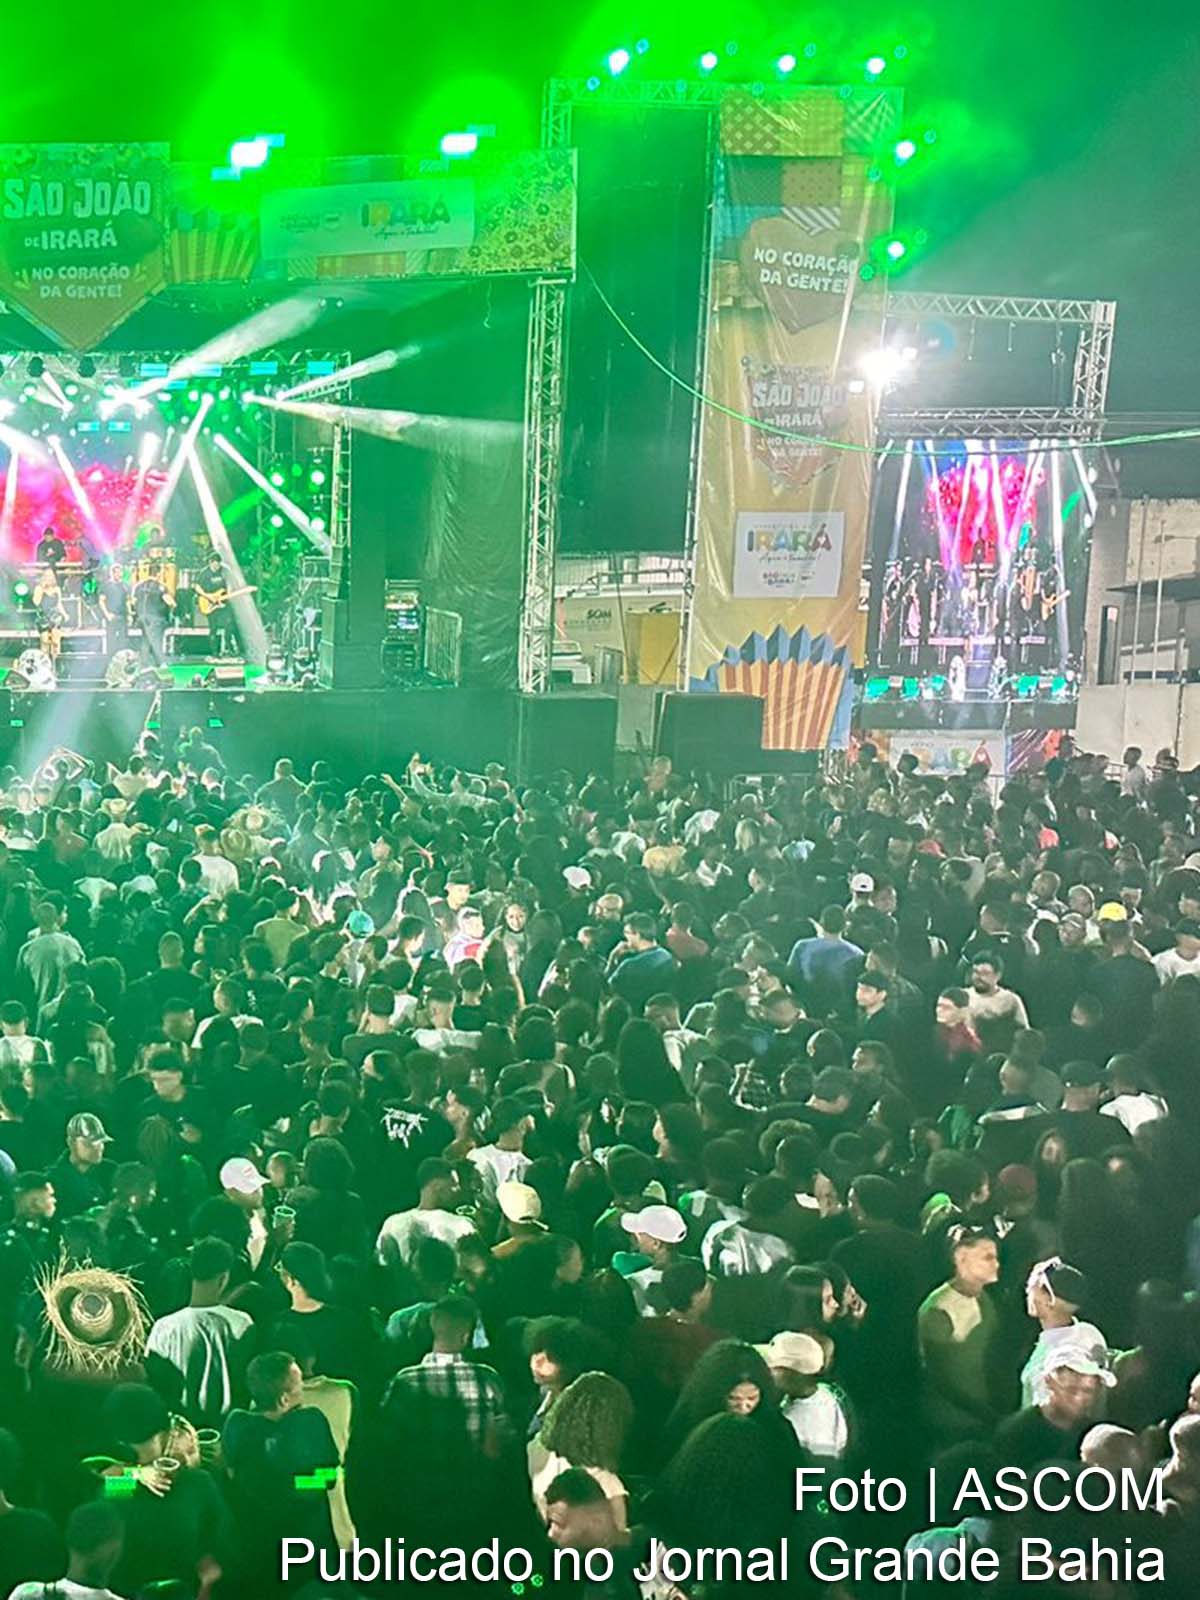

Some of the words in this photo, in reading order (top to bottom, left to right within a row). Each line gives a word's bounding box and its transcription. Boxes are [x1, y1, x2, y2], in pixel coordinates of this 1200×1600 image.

[3, 174, 64, 219] SÃO
[73, 174, 151, 219] JOÃO
[41, 220, 118, 250] IRARÁ
[31, 266, 53, 281] NO
[58, 262, 130, 284] CORAÇÃO
[754, 248, 778, 264] NO
[783, 251, 858, 277] CORAÇÃO
[39, 284, 62, 298] DA
[66, 284, 122, 299] GENTE!
[761, 268, 782, 285] DA
[787, 273, 849, 294] GENTE!
[747, 523, 832, 552] IRARÁ
